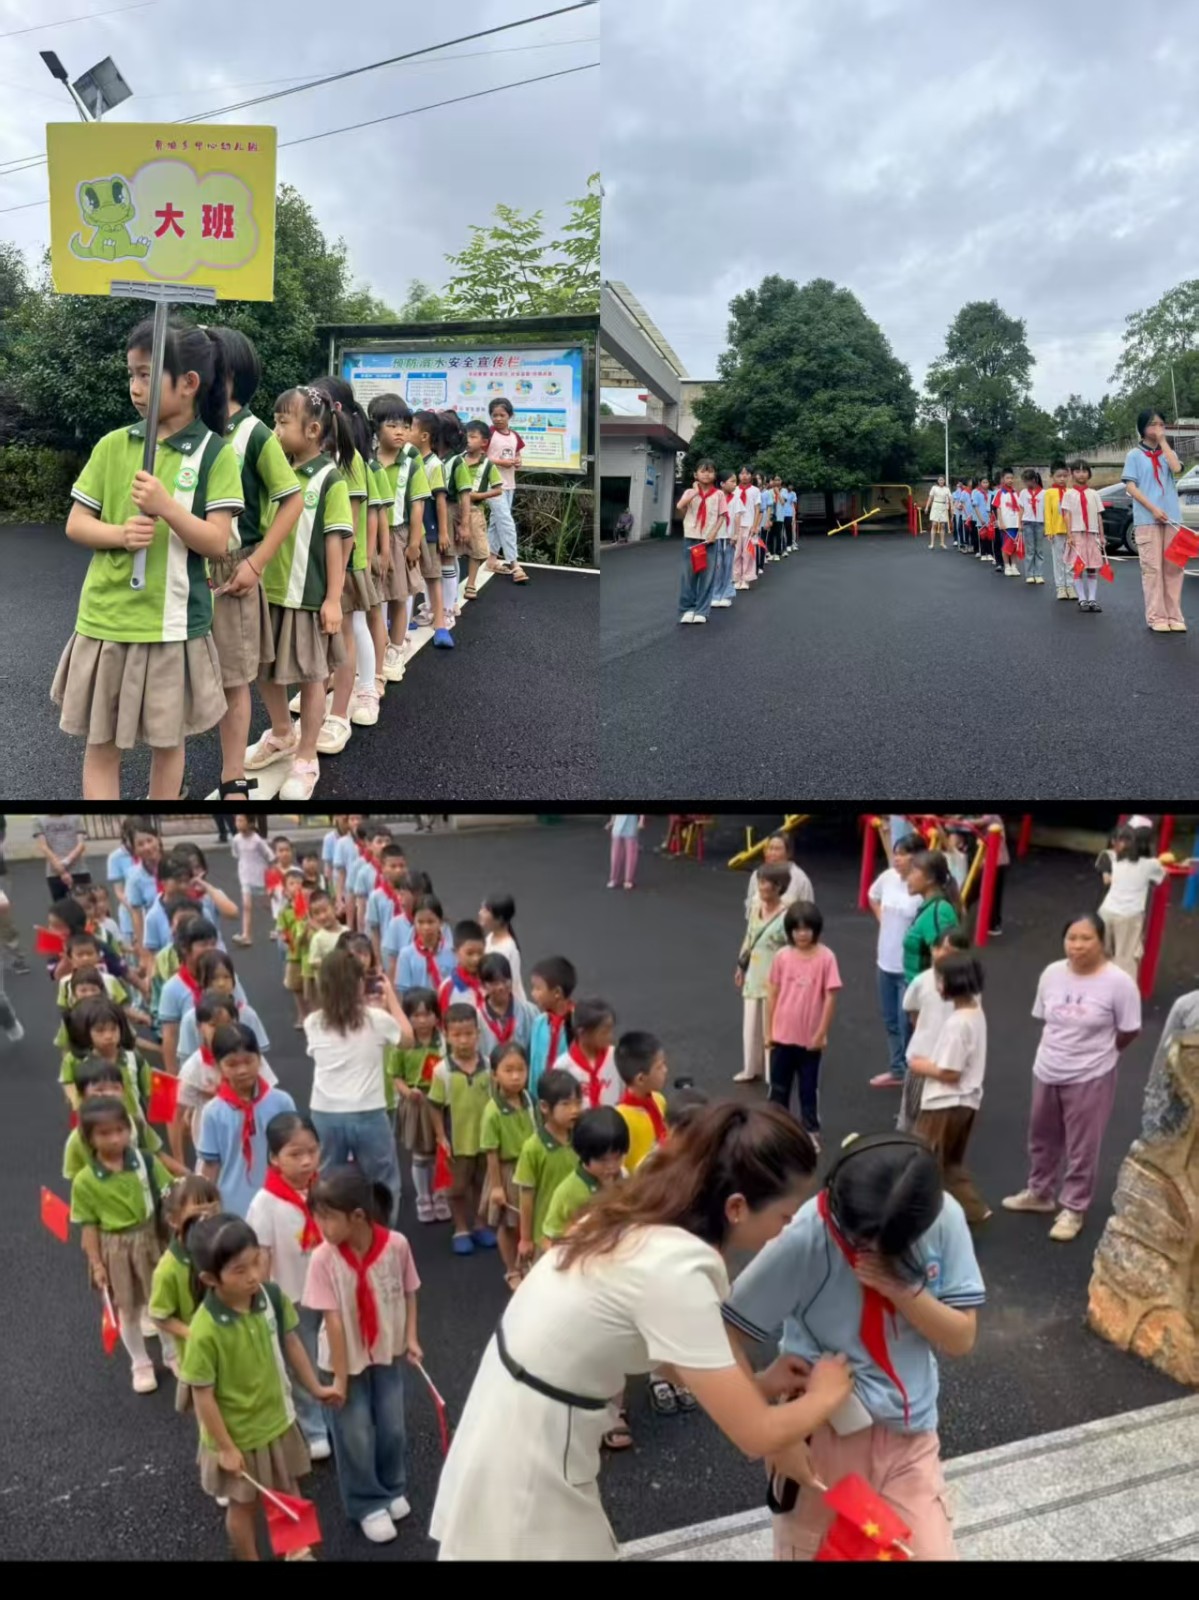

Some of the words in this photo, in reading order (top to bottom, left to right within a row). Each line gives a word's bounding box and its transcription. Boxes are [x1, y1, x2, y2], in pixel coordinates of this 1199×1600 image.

[154, 202, 235, 240] 大班
[392, 355, 522, 369] 预防溺水安全宣传栏
